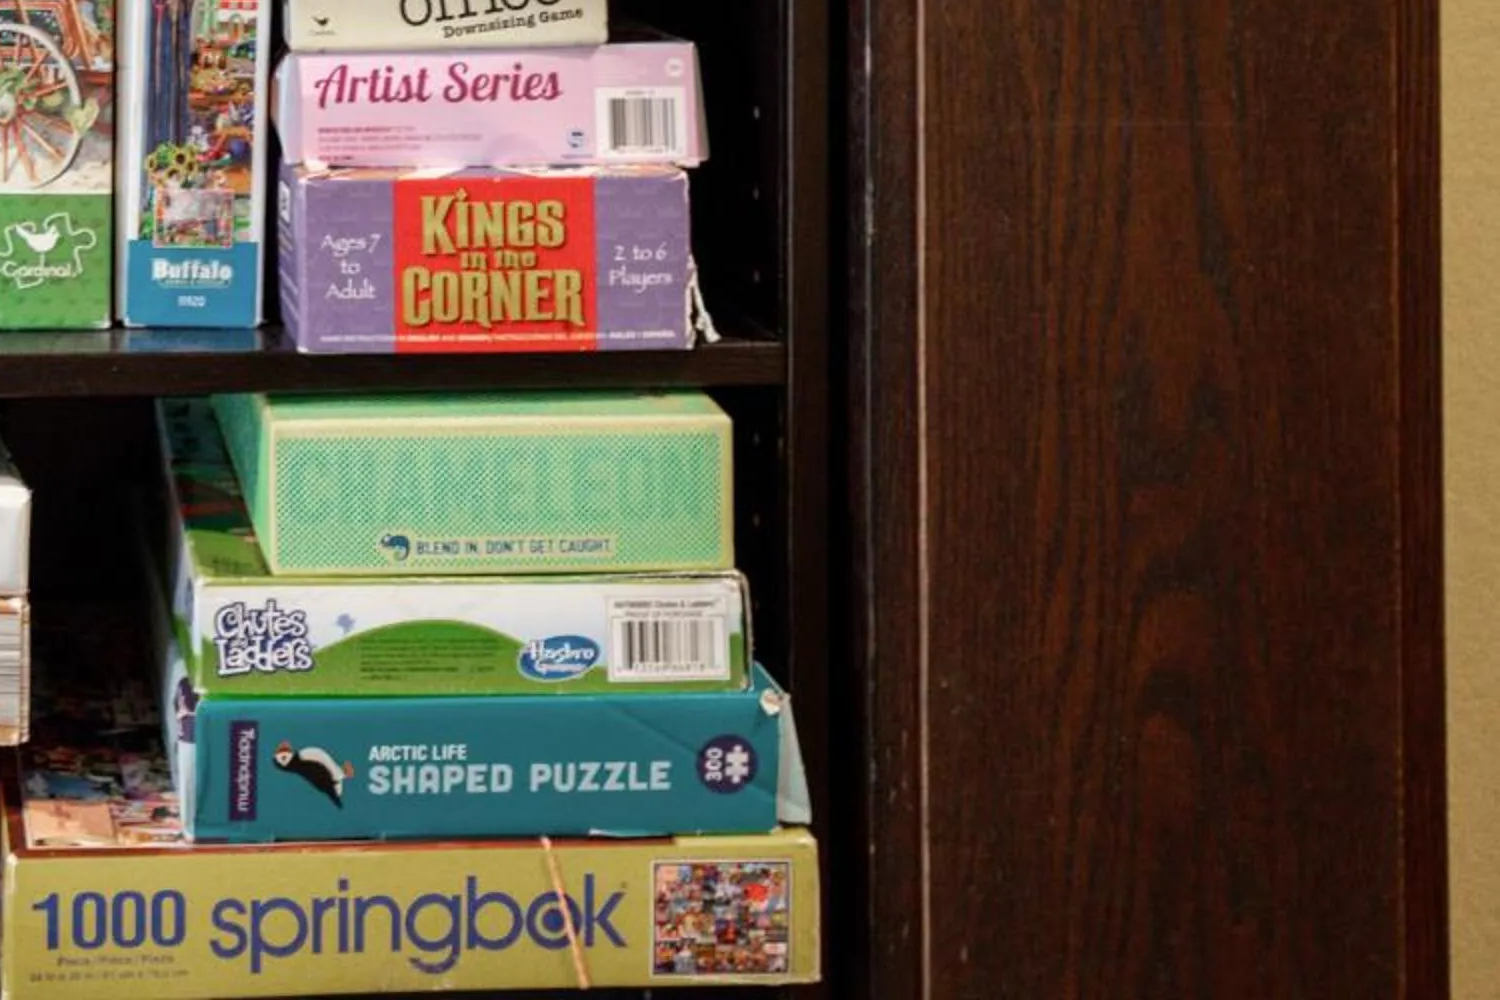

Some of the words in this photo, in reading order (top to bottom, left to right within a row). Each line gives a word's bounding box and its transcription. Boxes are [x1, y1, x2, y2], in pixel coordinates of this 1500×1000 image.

[443, 14, 536, 39] Downsizing
[539, 8, 584, 24] Game
[314, 61, 433, 109] Artist
[441, 61, 564, 104] Series
[320, 233, 367, 258] Ages
[368, 234, 381, 253] 7
[614, 246, 625, 261] 2
[632, 245, 653, 260] to
[655, 242, 667, 260] 6
[151, 257, 233, 281] Buffalo
[340, 259, 361, 274] to
[609, 266, 673, 293] Players
[325, 280, 377, 300] Adult
[402, 266, 585, 329] CORNER
[416, 540, 460, 555] BLEND
[529, 539, 553, 554] GET
[214, 599, 308, 638] Chutes
[214, 637, 314, 678] Ladders
[527, 640, 595, 664] Hasbro
[368, 743, 428, 761] ARCTIC
[432, 744, 467, 761] LIFE
[706, 747, 723, 782] 300
[368, 764, 514, 796] SHAPED
[530, 761, 672, 792] PUZZLE
[31, 888, 187, 952] 1000
[209, 873, 627, 974] springbok
